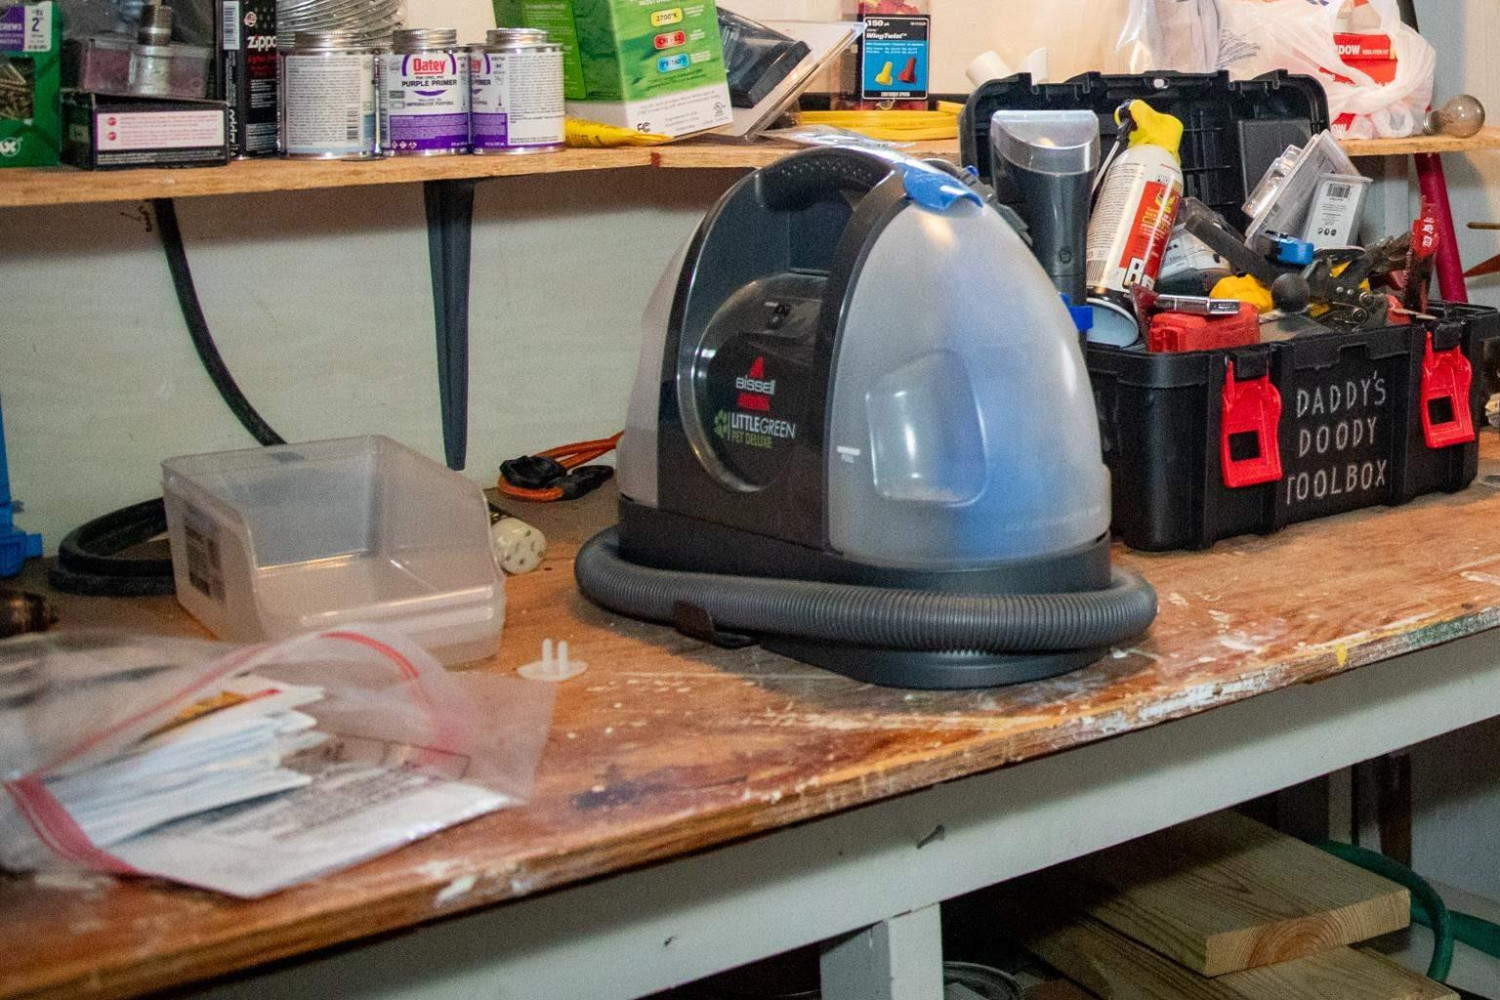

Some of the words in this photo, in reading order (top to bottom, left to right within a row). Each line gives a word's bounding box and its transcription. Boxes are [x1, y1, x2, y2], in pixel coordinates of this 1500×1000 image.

[402, 79, 430, 87] PURPLE
[431, 79, 458, 87] PRIMER
[413, 58, 446, 74] Oatey
[1297, 370, 1386, 418] DADDY'S
[1299, 416, 1377, 458] DOODY
[1286, 459, 1387, 505] TOOLBOX
